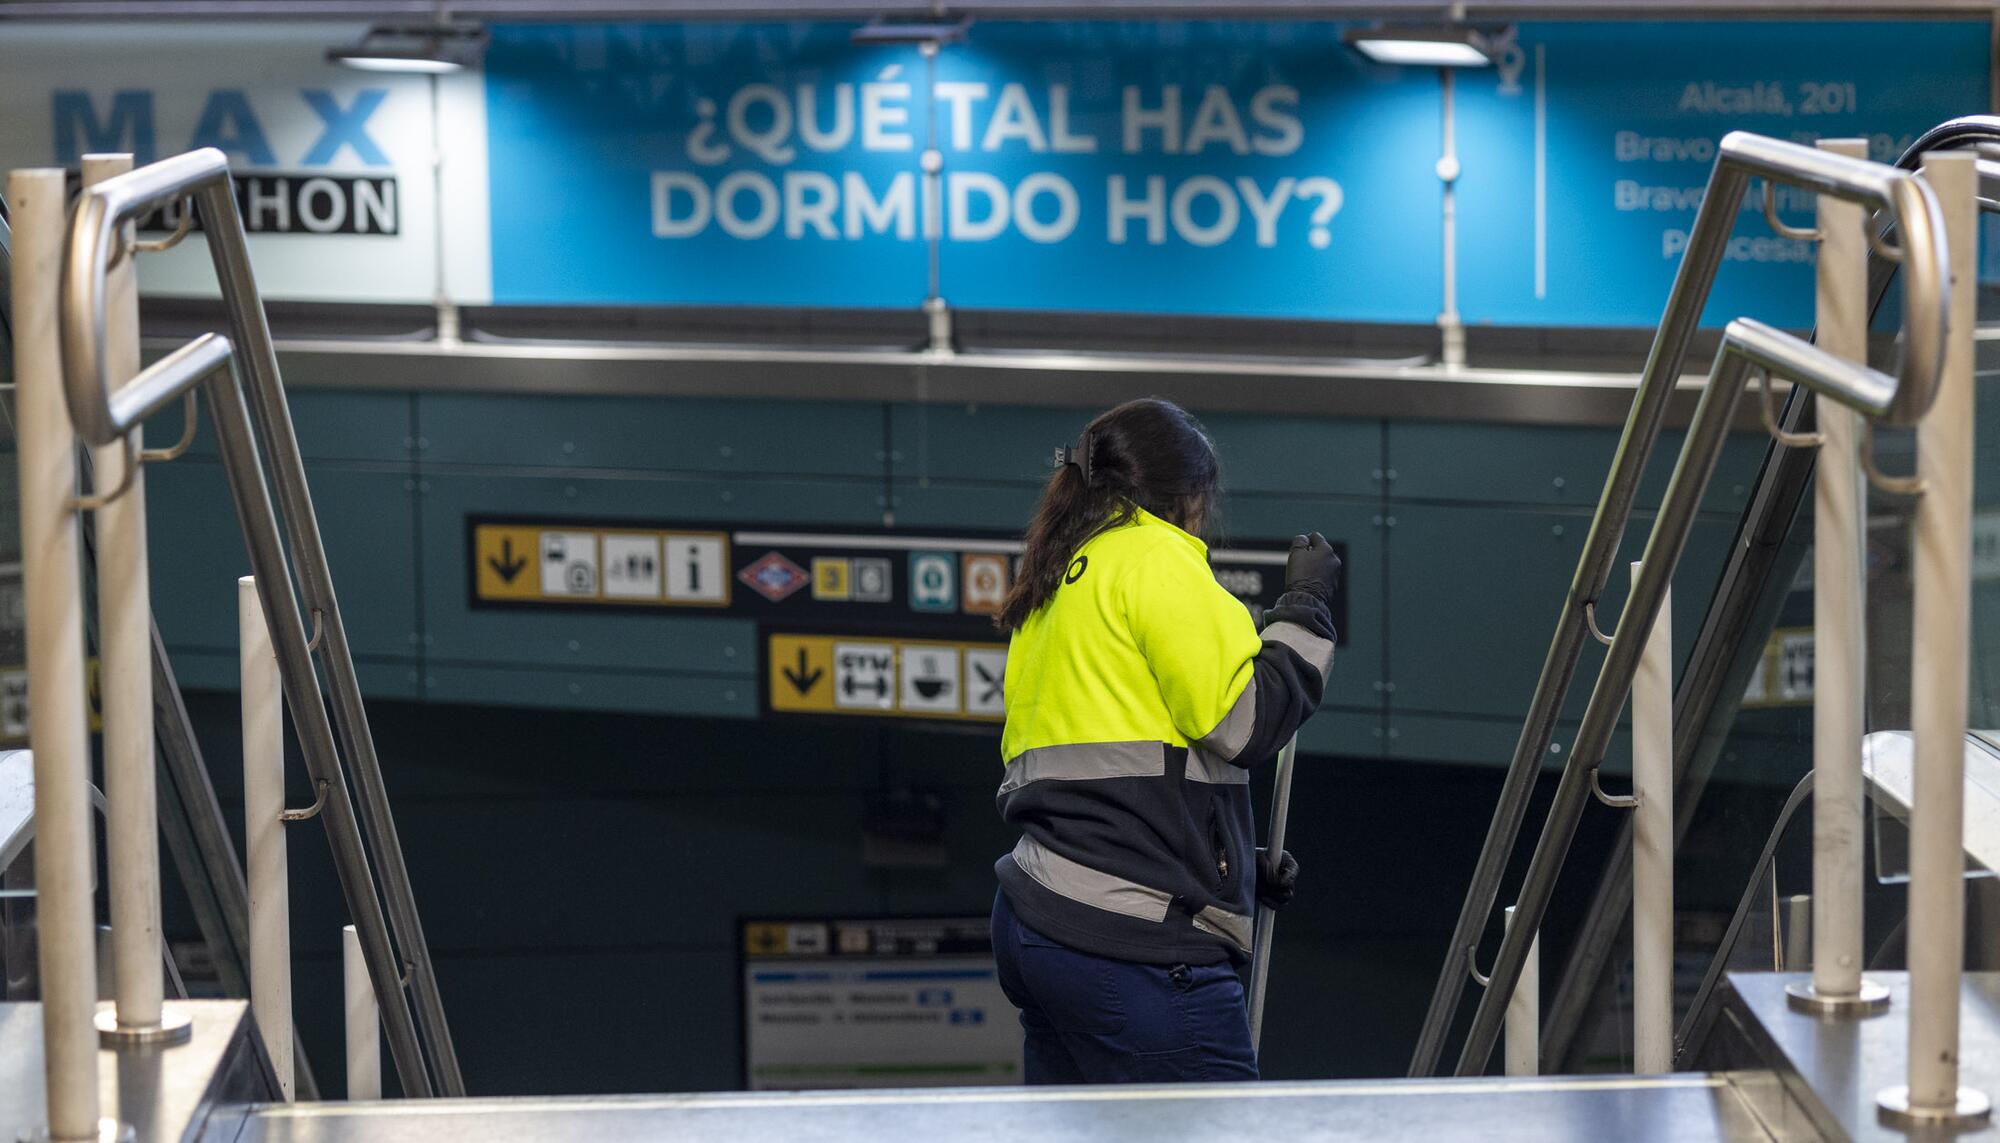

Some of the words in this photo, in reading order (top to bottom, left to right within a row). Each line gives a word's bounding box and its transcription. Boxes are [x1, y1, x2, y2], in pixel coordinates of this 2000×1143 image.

[52, 88, 392, 165] MAX
[685, 66, 914, 165] ¿QUÉ
[932, 83, 1097, 153] TAL
[1122, 86, 1304, 157] HAS
[1678, 81, 1794, 116] Alcalá,
[1800, 82, 1858, 113] 201
[1614, 130, 1715, 162] Bravo
[651, 171, 1082, 244] DORMIDO
[1106, 174, 1344, 249] HOY?
